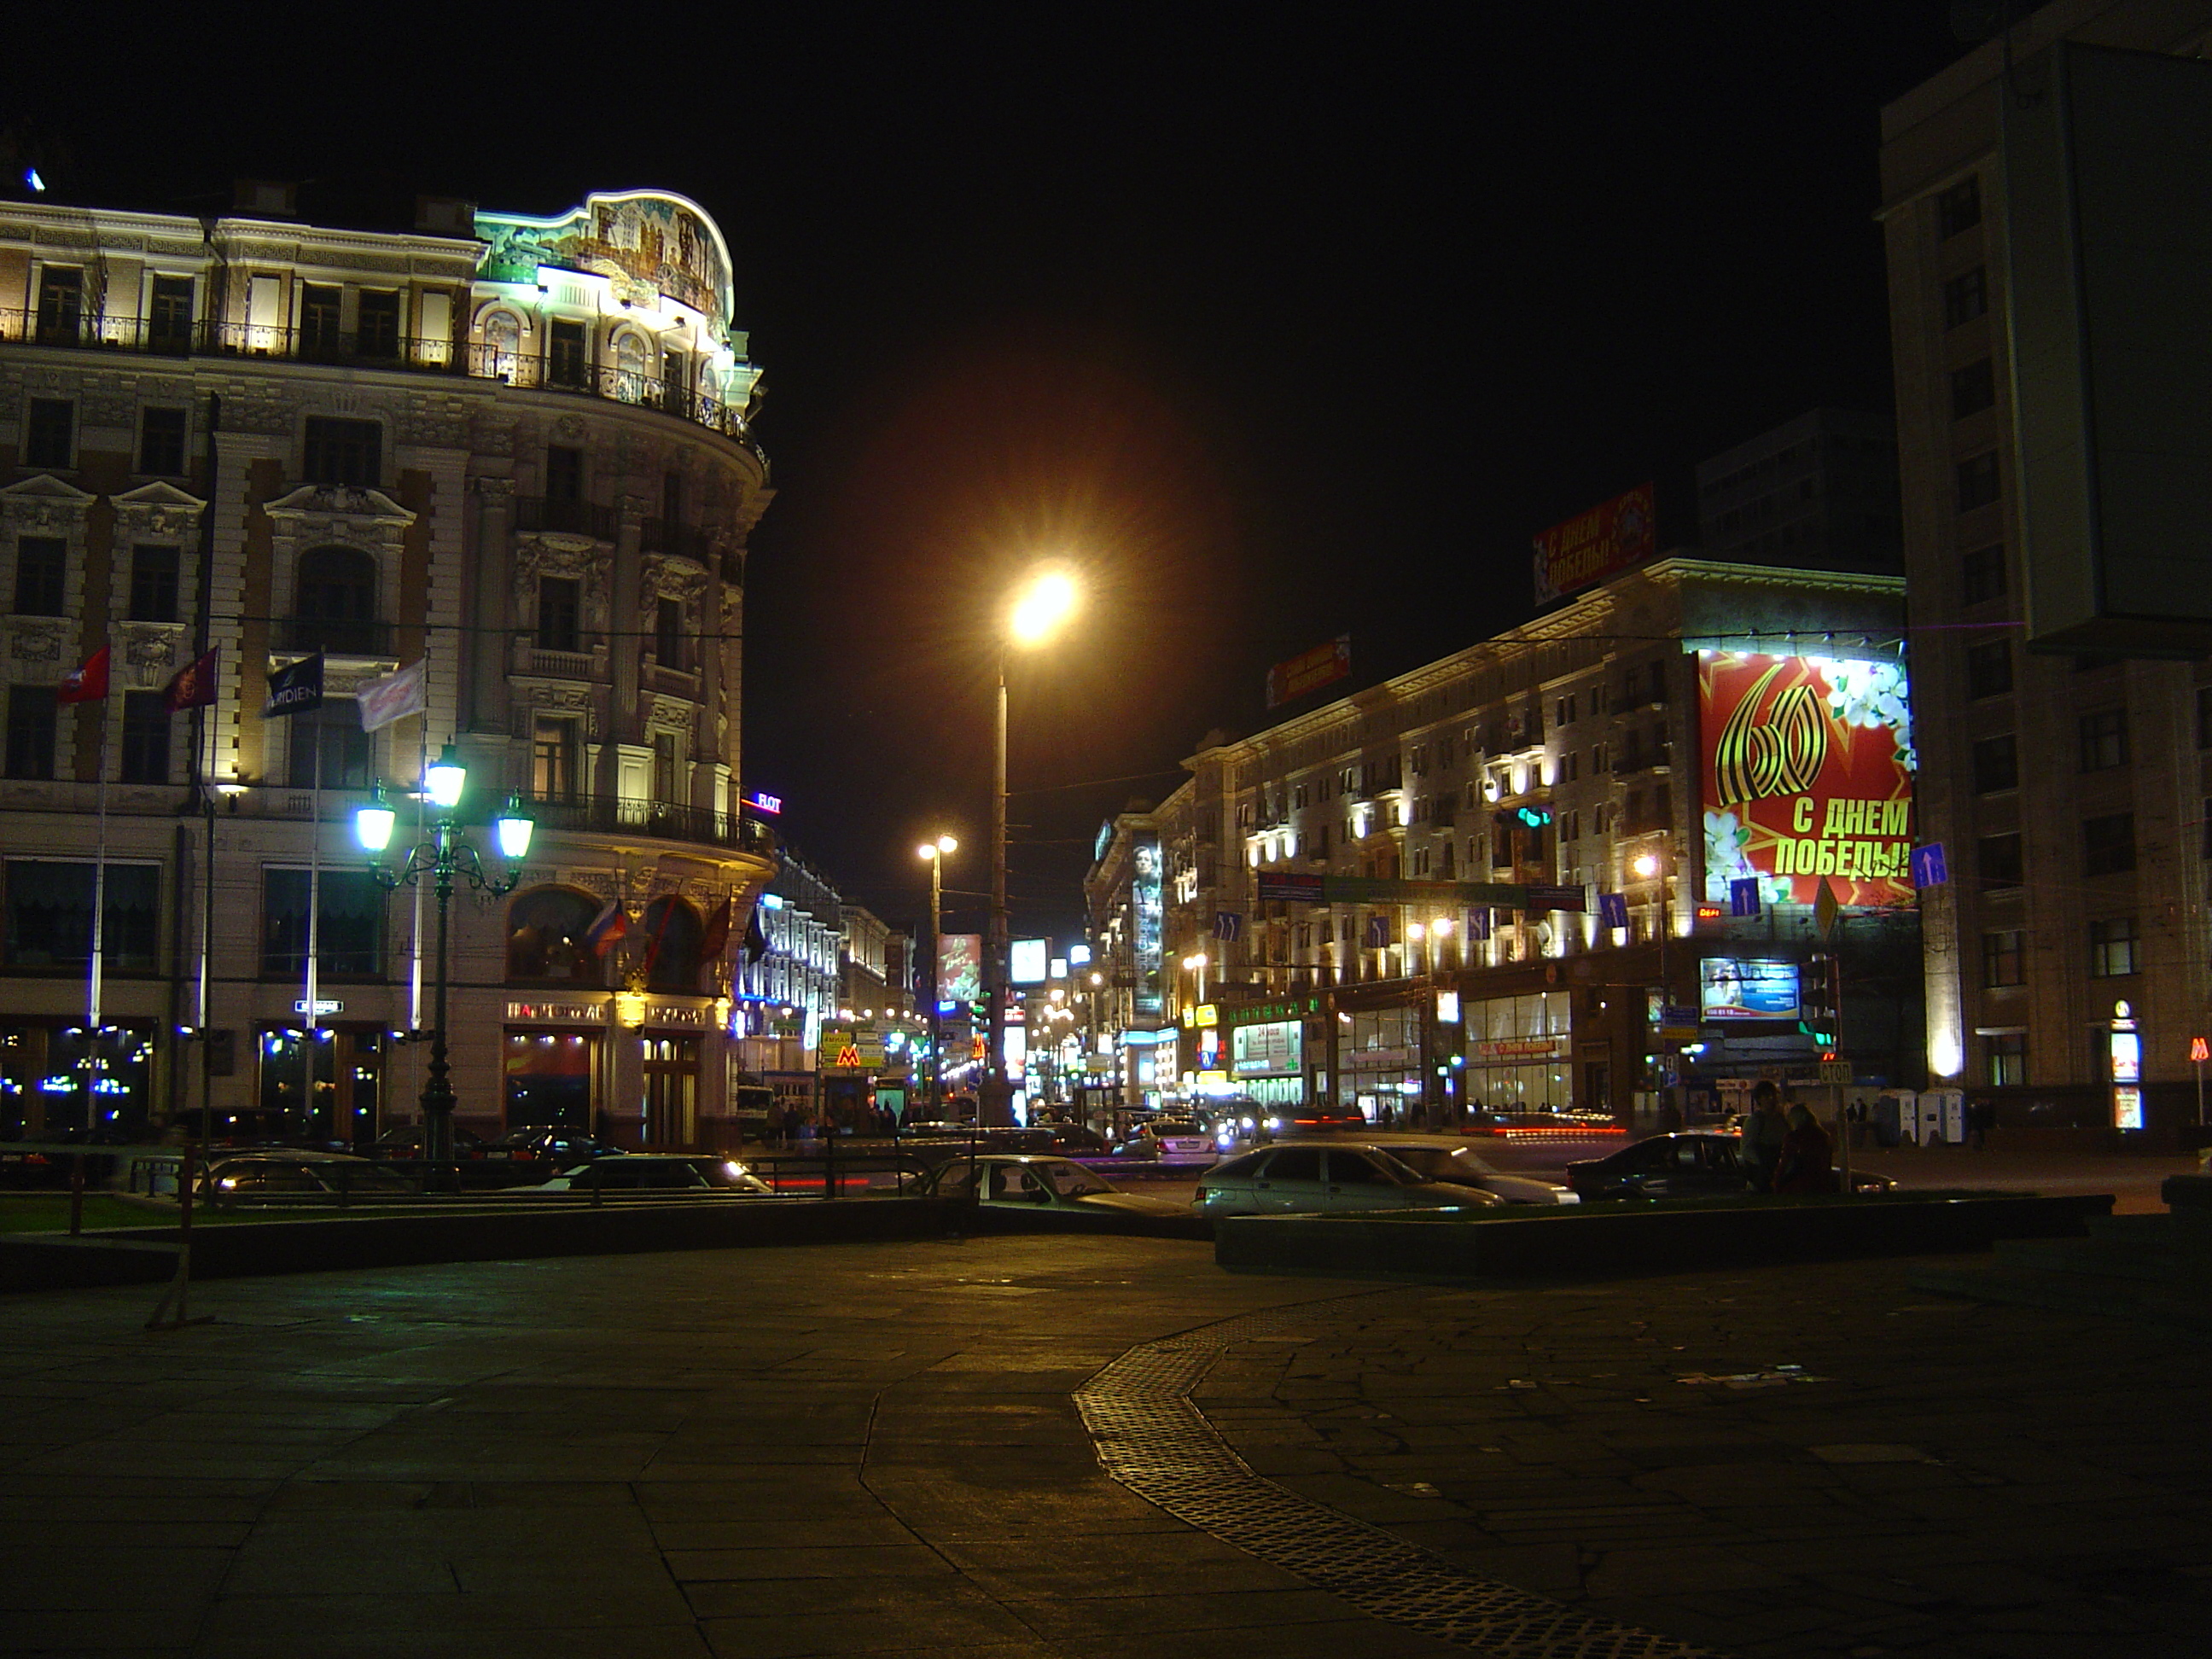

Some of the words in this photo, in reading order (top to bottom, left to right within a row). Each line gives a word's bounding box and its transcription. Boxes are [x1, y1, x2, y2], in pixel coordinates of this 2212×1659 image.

[1560, 512, 1601, 557] ДНЕМ
[1715, 663, 1827, 806] 60
[1793, 796, 1814, 833] С
[1822, 798, 1909, 839] ДНЕМ
[1774, 838, 1911, 882] ПОБЕДЫ!
[837, 1045, 860, 1066] М
[1822, 1064, 1850, 1081] СТОП
